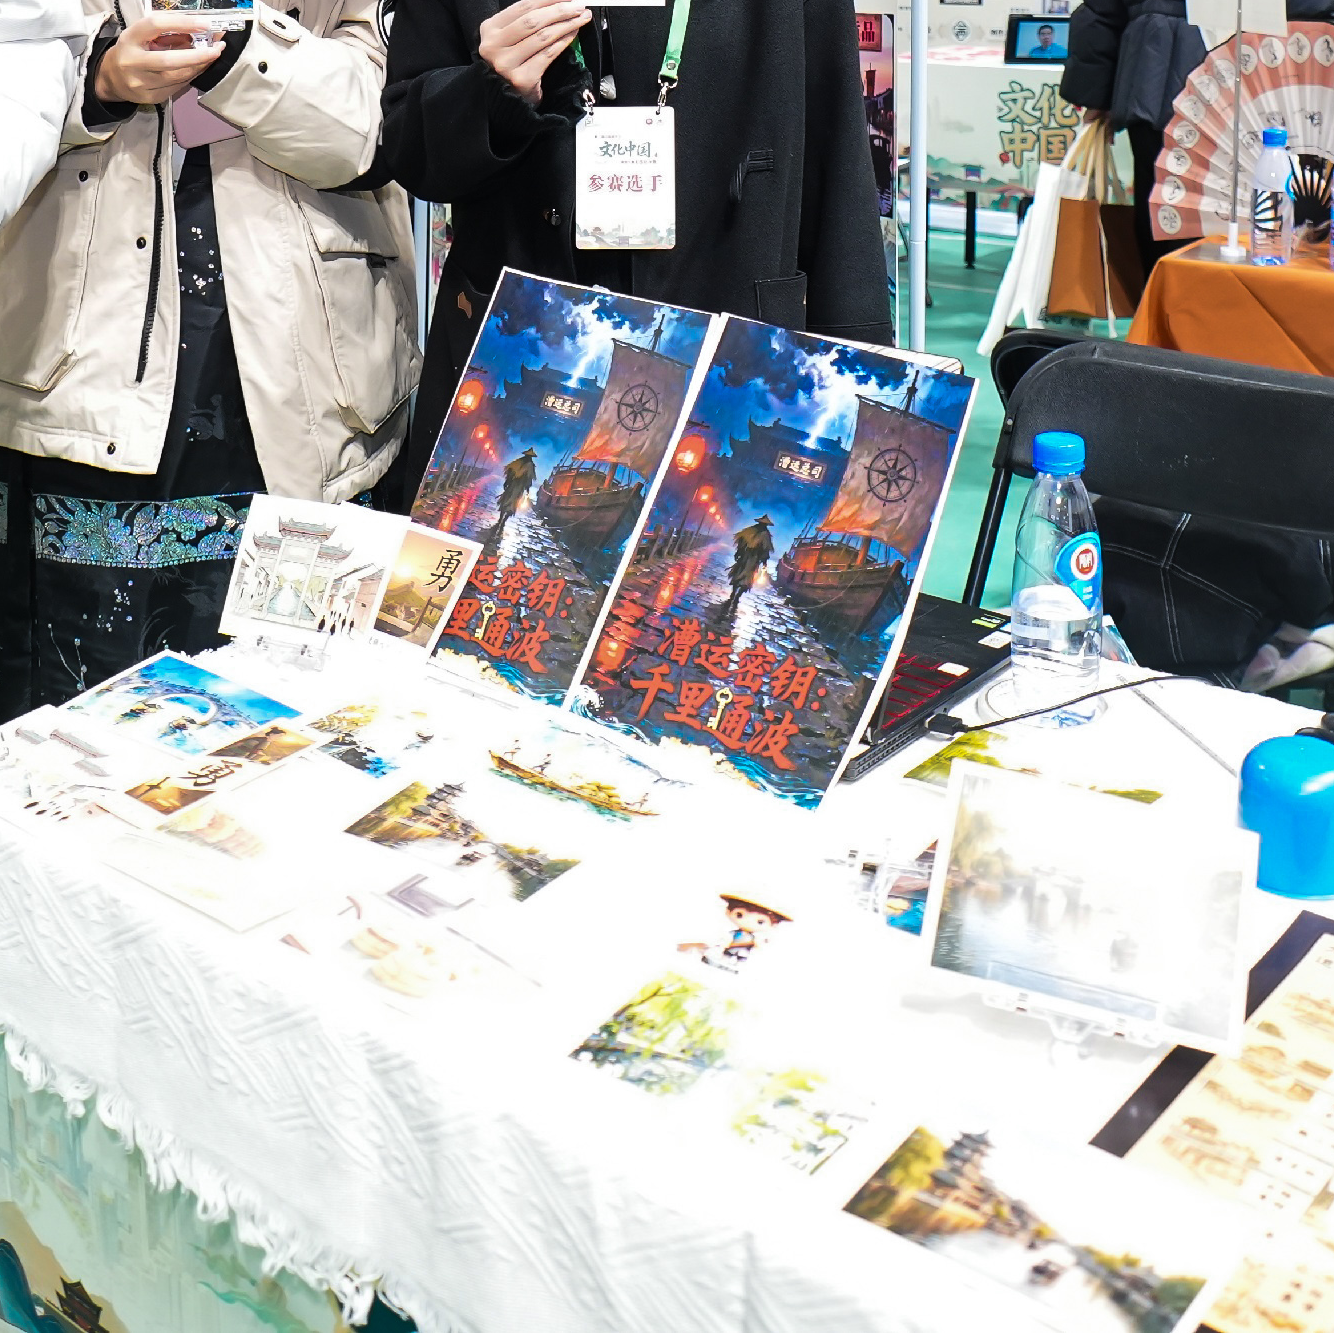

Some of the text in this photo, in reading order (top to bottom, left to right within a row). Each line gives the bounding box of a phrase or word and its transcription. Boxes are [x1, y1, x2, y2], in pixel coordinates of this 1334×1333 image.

[997, 81, 1079, 127] 文化
[599, 140, 651, 158] 文化中国
[999, 121, 1075, 167] 中国
[423, 549, 464, 593] 勇
[659, 618, 827, 711] 漕运密钥：
[631, 662, 799, 770] 千里通波
